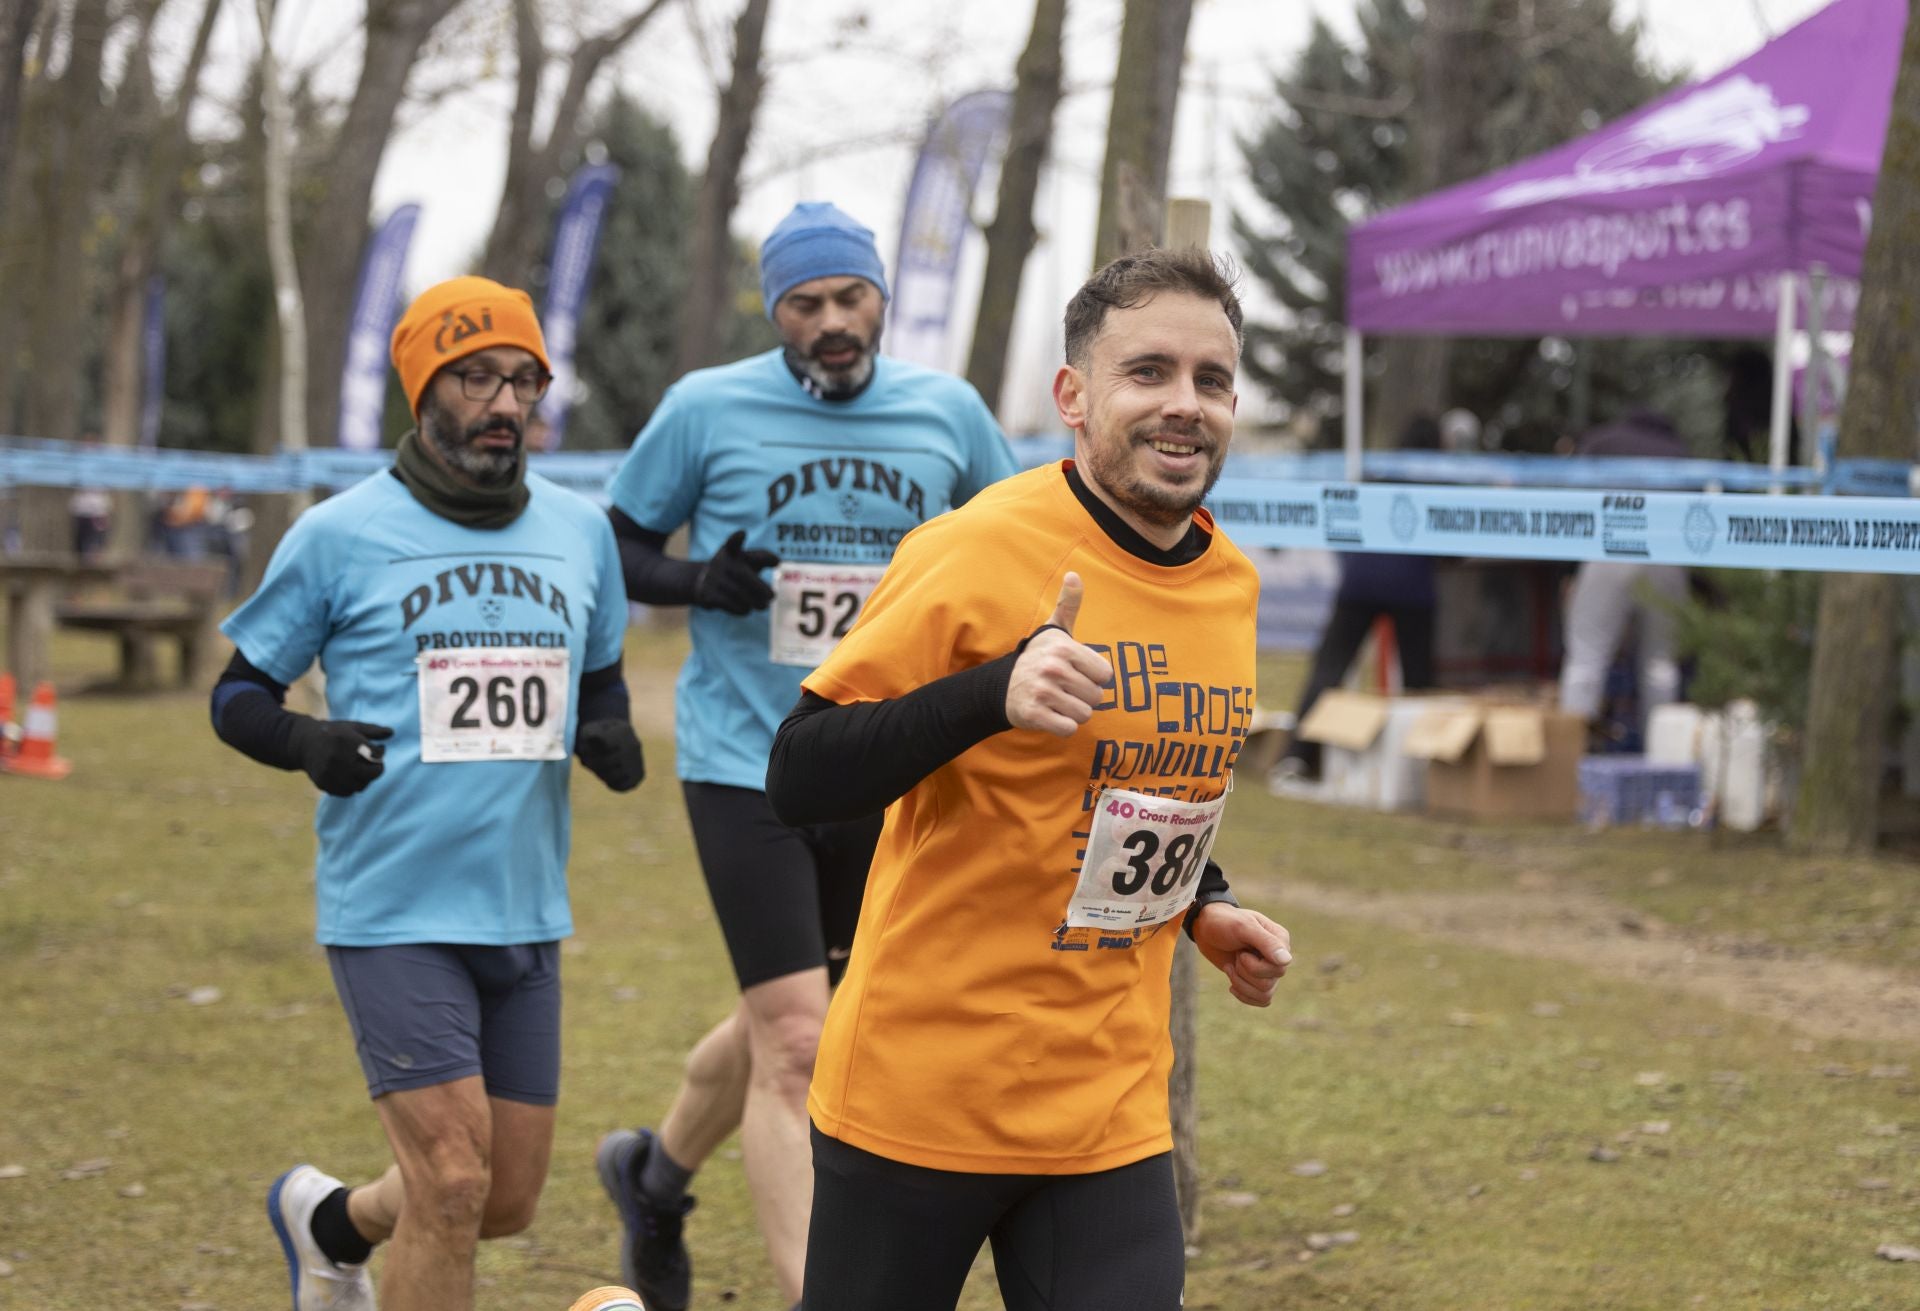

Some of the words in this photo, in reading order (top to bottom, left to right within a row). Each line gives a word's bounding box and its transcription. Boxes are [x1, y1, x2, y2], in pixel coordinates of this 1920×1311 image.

[767, 458, 925, 522] DIVINA
[1602, 495, 1646, 510] FMD
[777, 524, 908, 545] PROVIDENC
[1791, 518, 1850, 547] MUNICIPAL
[1854, 519, 1869, 549] DE
[1872, 520, 1920, 551] DEPORT
[401, 563, 573, 631] DIVINA
[416, 631, 566, 652] PROVIDENCIA
[449, 676, 546, 729] 260
[1155, 682, 1252, 737] CROSS
[1106, 800, 1134, 819] 40
[1138, 808, 1168, 823] Cross
[1170, 813, 1208, 825] Rondilla
[1112, 824, 1214, 895] 388
[1097, 936, 1132, 949] FMD
